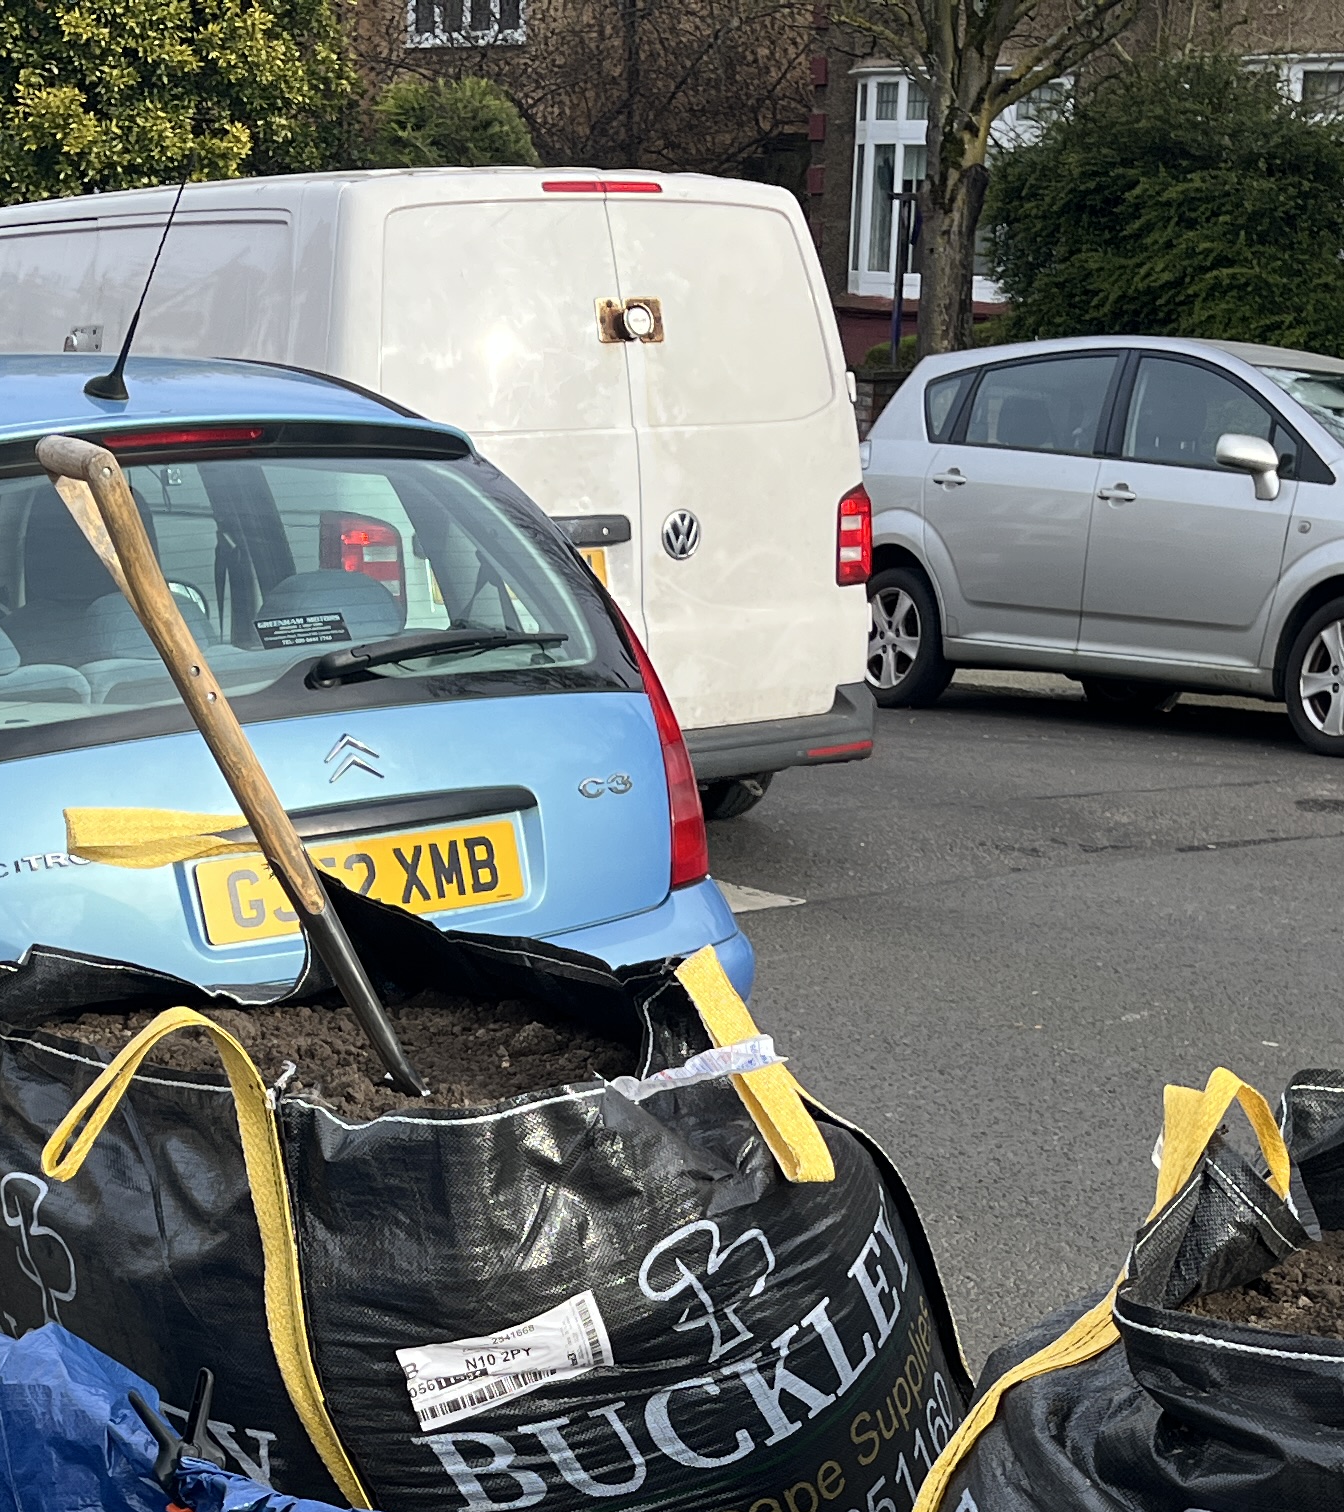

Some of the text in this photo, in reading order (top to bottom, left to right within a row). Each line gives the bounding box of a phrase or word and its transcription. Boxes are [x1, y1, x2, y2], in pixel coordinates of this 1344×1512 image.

[578, 773, 633, 799] C3
[392, 836, 499, 904] XMB
[465, 1346, 532, 1371] N10 2PY
